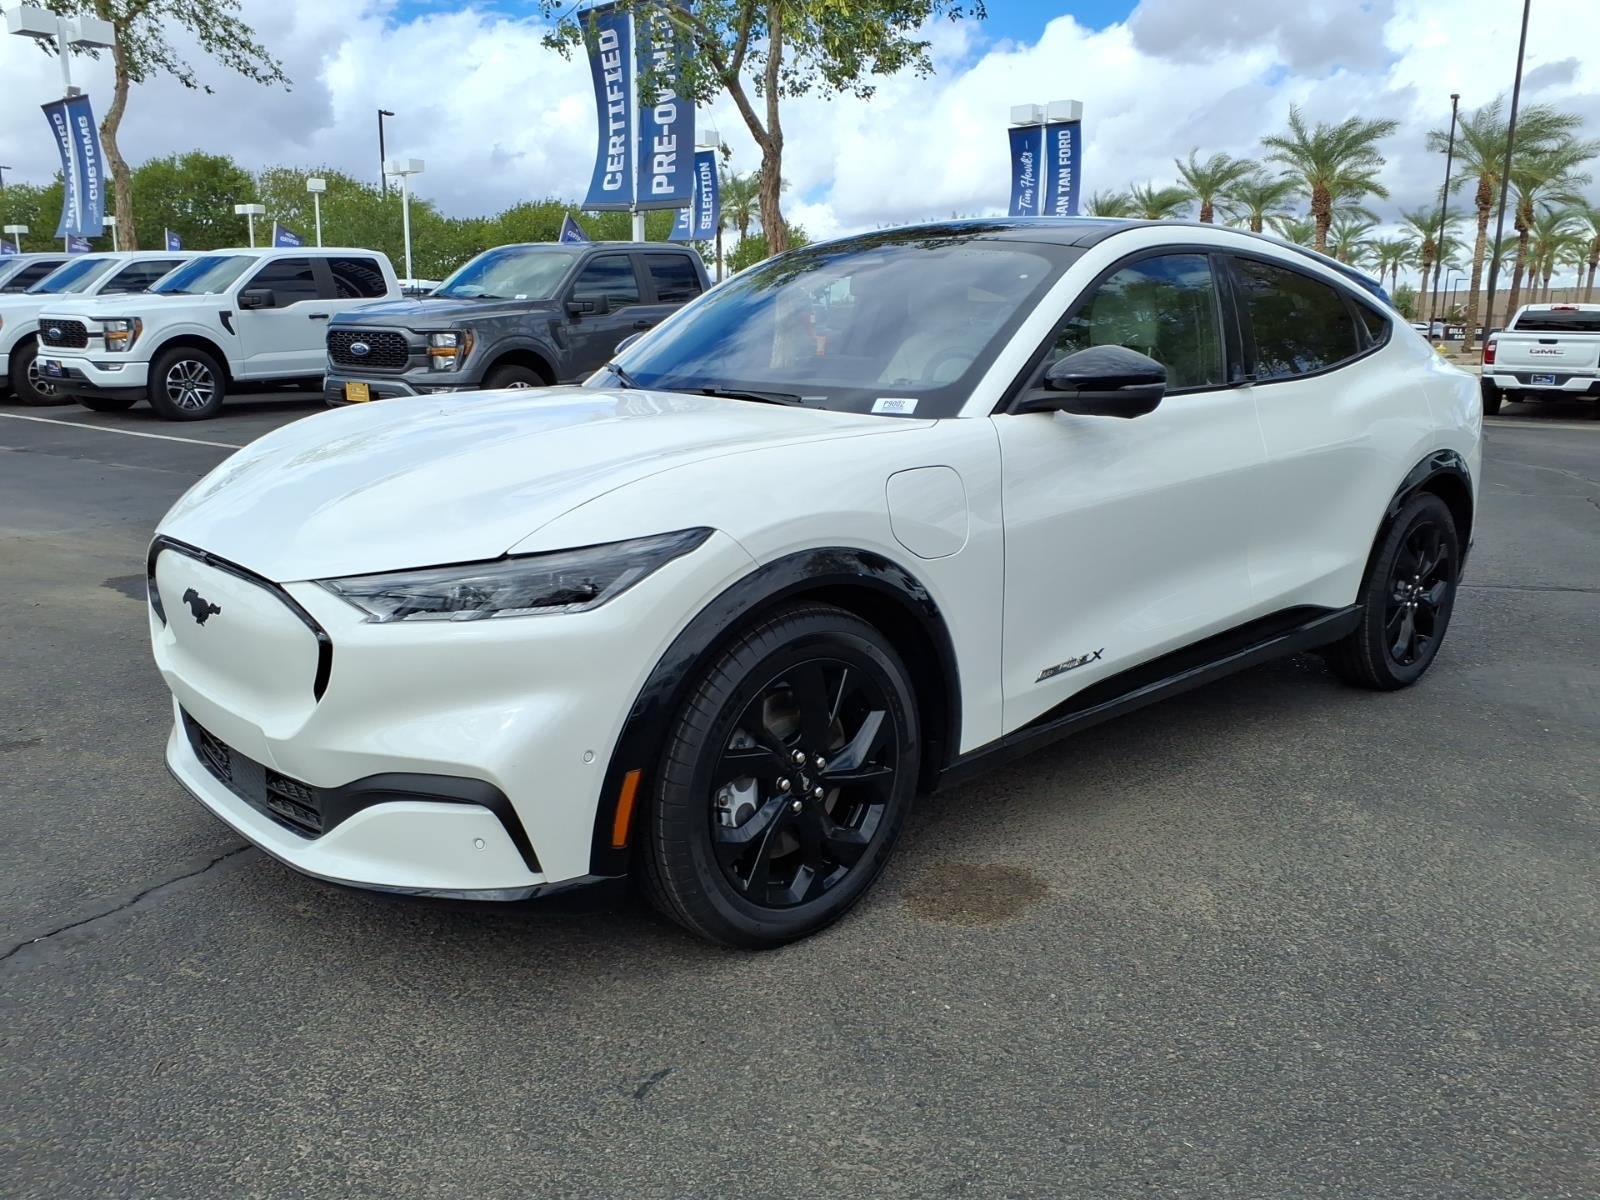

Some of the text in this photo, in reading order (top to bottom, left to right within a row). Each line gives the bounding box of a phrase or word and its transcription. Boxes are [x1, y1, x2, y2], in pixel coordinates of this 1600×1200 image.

[598, 28, 625, 192] CERTIFIED
[77, 115, 99, 201] CUSTOMS
[1059, 130, 1071, 165] FORD
[699, 162, 713, 230] SELECTION
[1018, 189, 1033, 210] Tim
[1058, 168, 1071, 194] TAN
